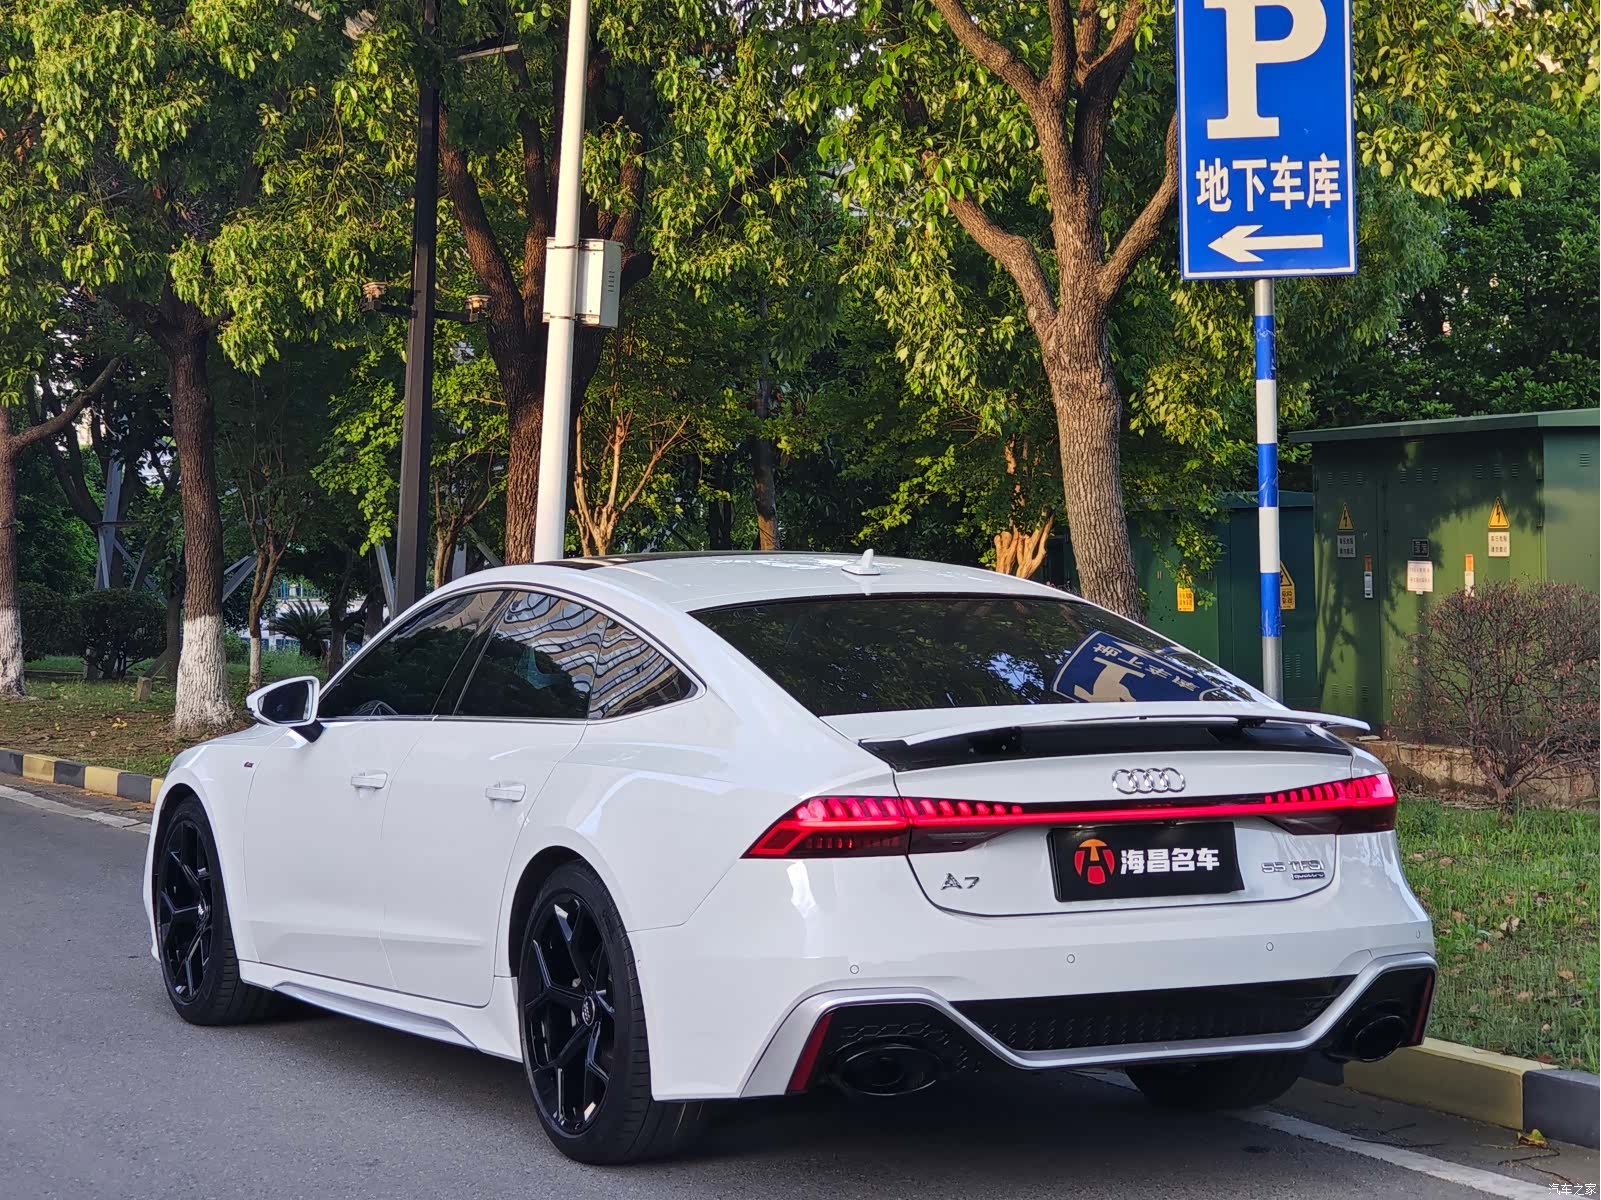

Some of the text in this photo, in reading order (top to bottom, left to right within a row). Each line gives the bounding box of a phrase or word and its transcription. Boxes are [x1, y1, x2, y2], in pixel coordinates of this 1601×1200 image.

[1204, 0, 1327, 139] P
[1196, 153, 1342, 213] 地下车库
[1120, 848, 1220, 875] 海昌名车
[1261, 860, 1325, 873] 55 TFSI
[940, 872, 980, 890] A7
